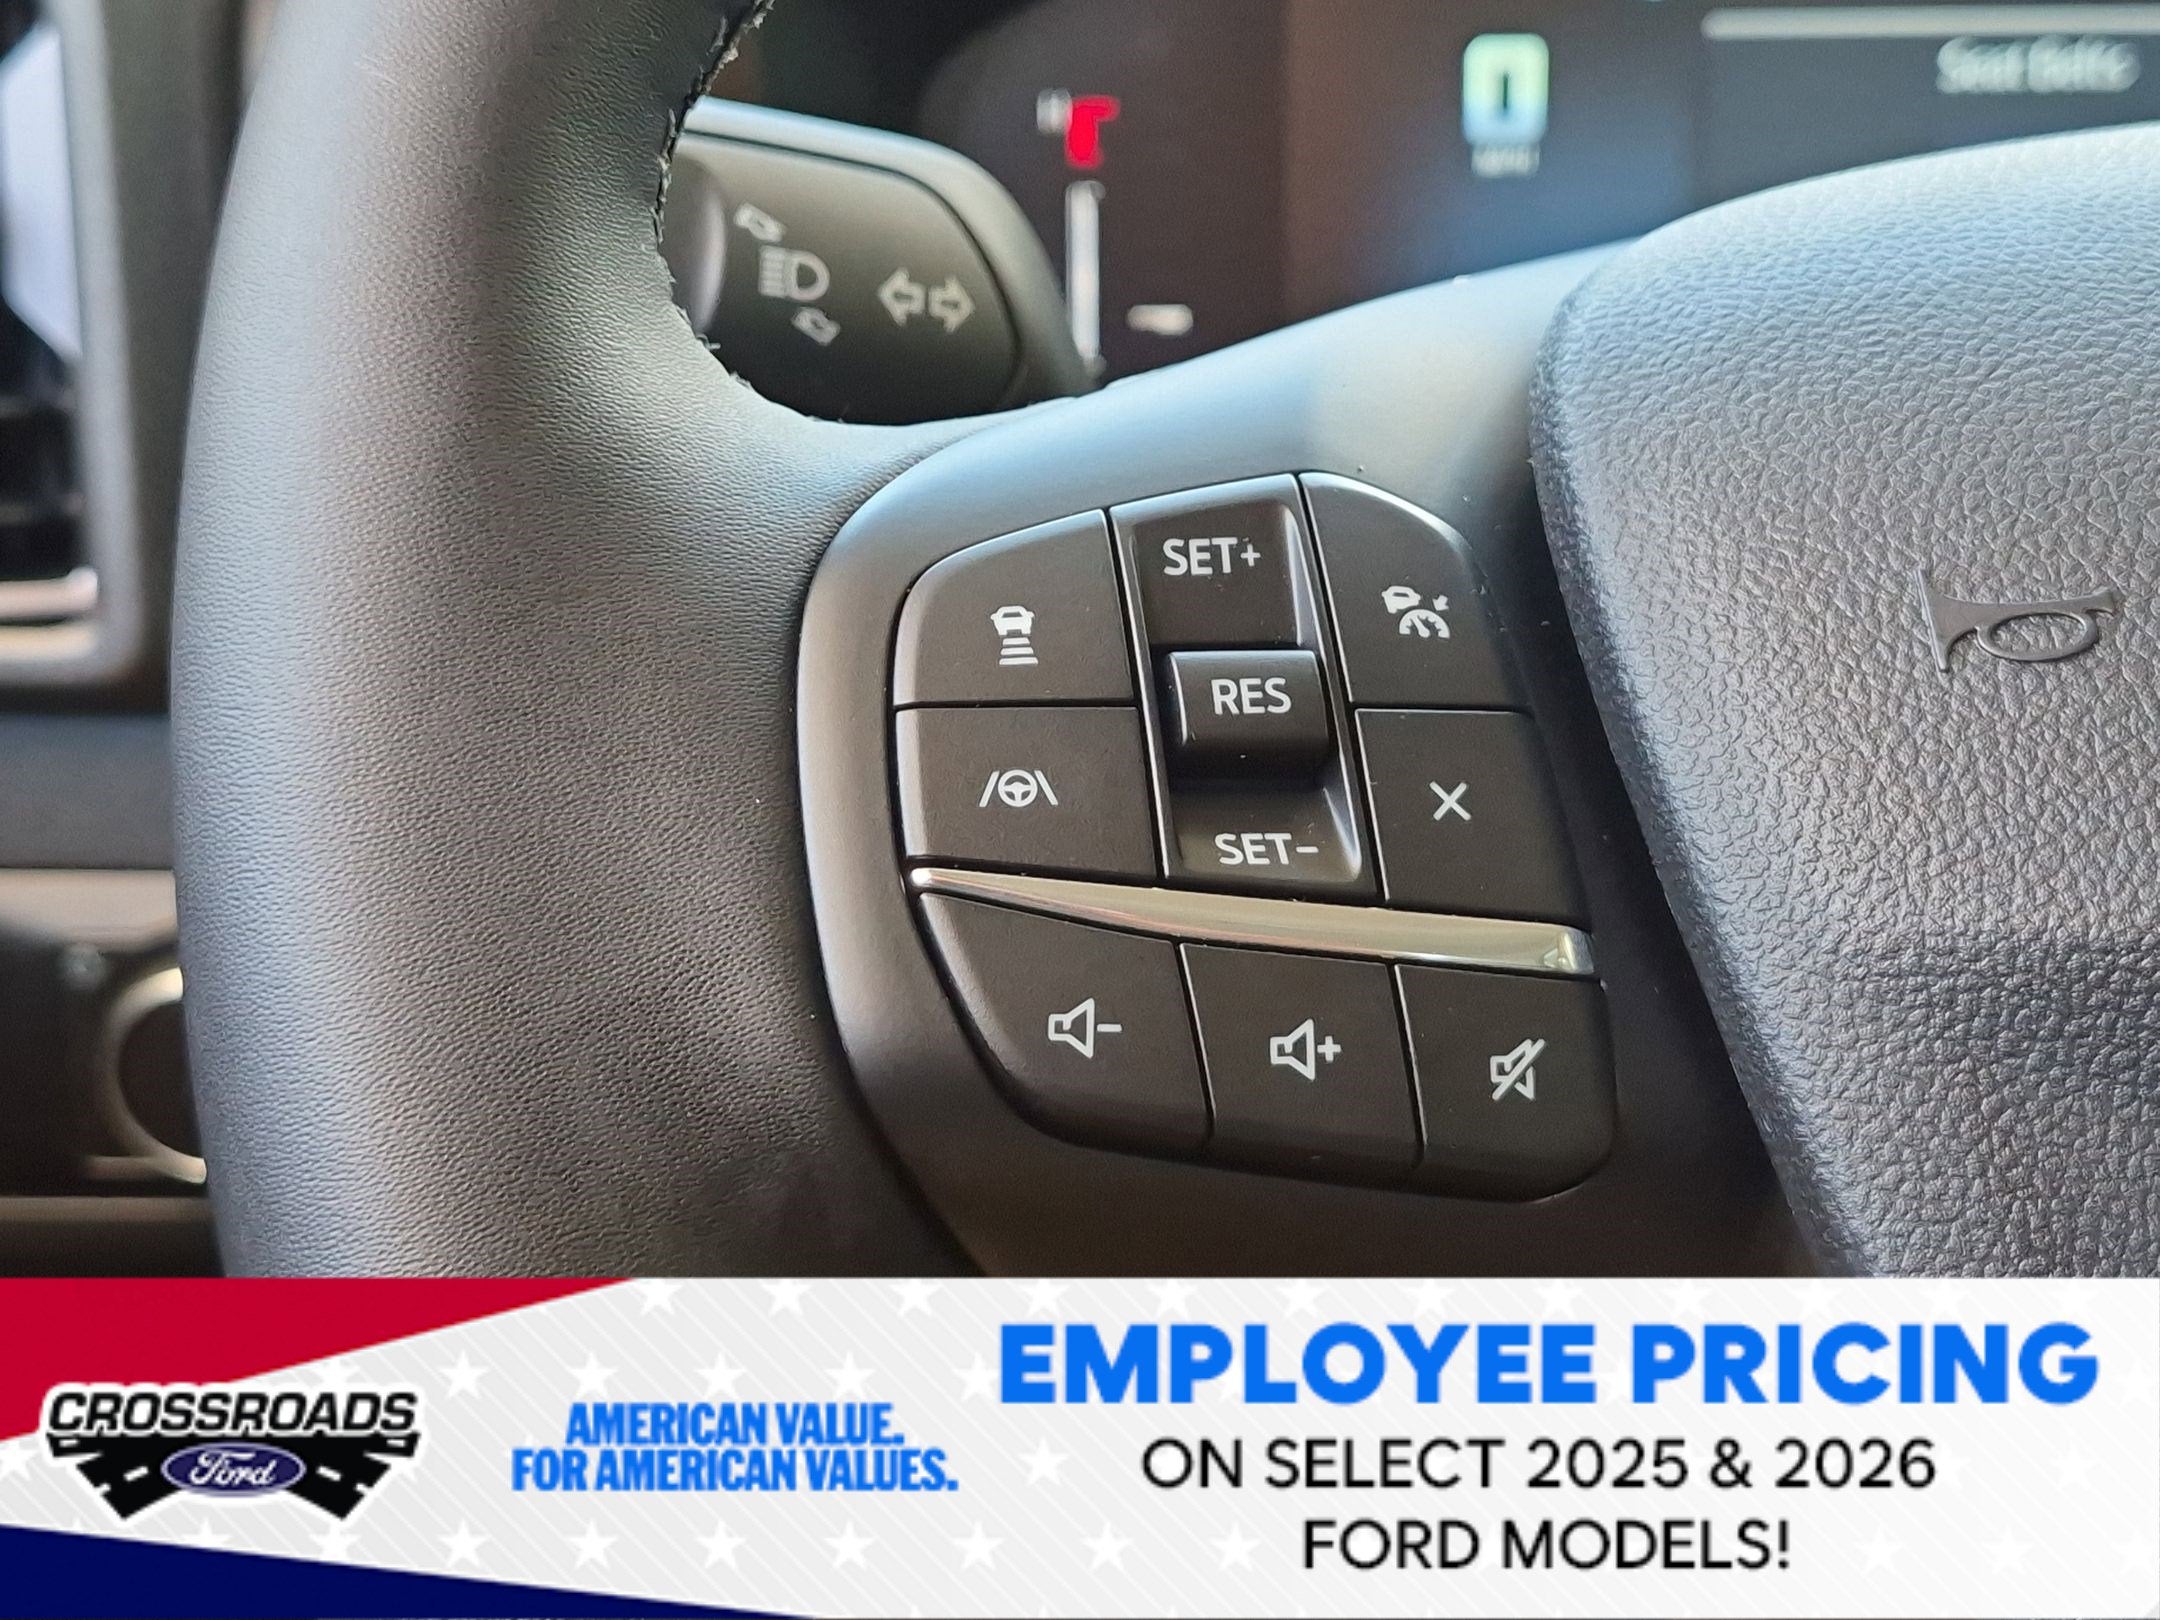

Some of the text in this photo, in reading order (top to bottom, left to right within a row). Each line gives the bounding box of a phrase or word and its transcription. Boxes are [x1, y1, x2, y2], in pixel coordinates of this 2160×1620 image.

[1162, 537, 1261, 576] SET+
[1211, 678, 1292, 715] RES
[1214, 832, 1319, 866] SET-
